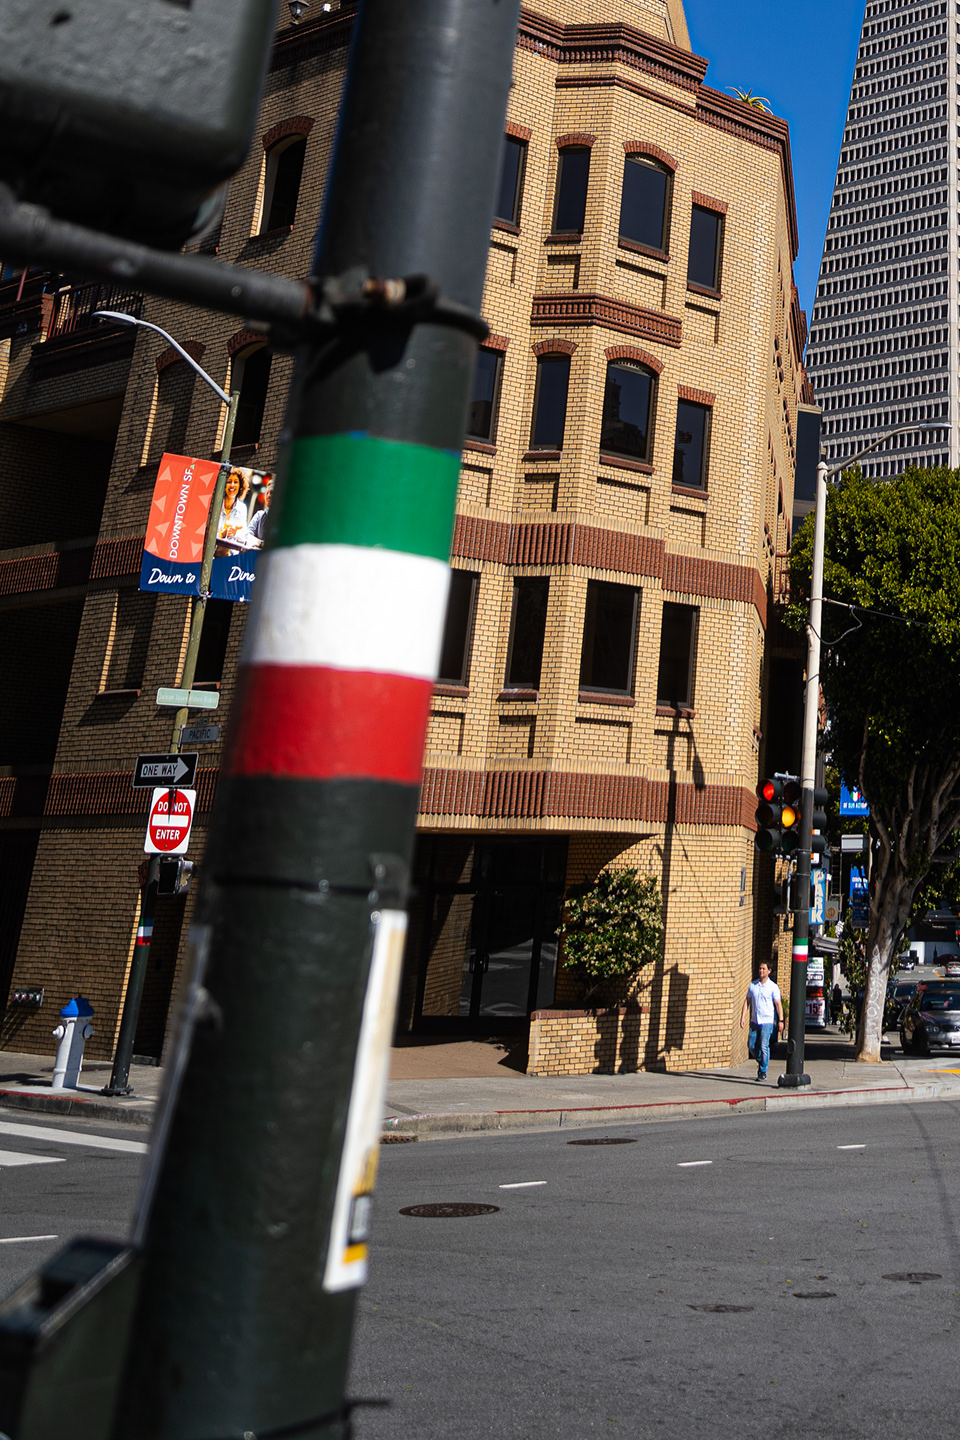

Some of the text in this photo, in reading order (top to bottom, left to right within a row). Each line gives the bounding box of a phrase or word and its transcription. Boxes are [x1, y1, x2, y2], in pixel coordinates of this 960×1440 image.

[169, 468, 193, 559] DOWNTOWN SF
[148, 568, 196, 585] Down to
[228, 566, 256, 582] Dine
[189, 729, 211, 739] PACIFIC
[143, 763, 178, 776] ONE WAY
[157, 801, 188, 813] DO NOT
[155, 829, 181, 840] ENTER
[811, 870, 824, 923] PARK
